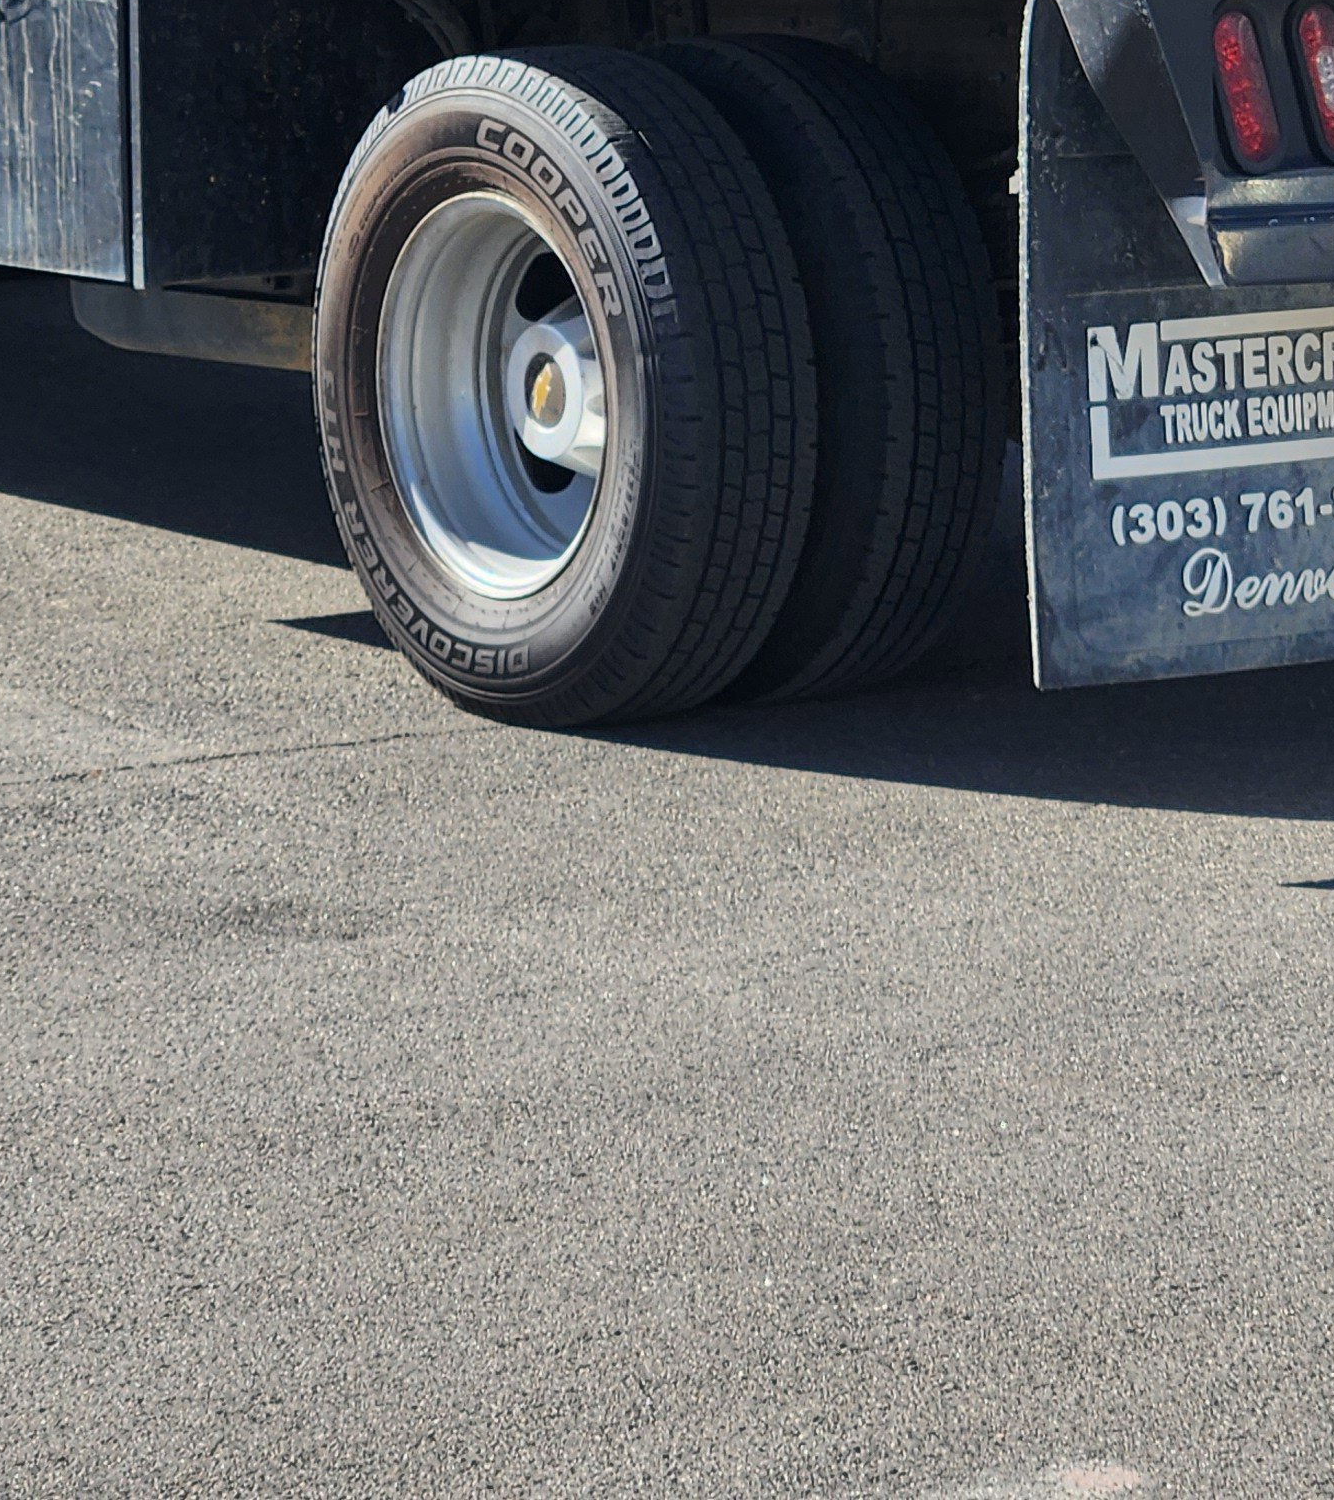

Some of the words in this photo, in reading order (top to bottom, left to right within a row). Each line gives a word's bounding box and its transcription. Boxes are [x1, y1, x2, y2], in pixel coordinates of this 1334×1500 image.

[475, 116, 624, 321] COOPER
[1160, 398, 1242, 444] TRUCK
[1110, 497, 1227, 548] (303)
[343, 498, 532, 676] DISCOVERER
